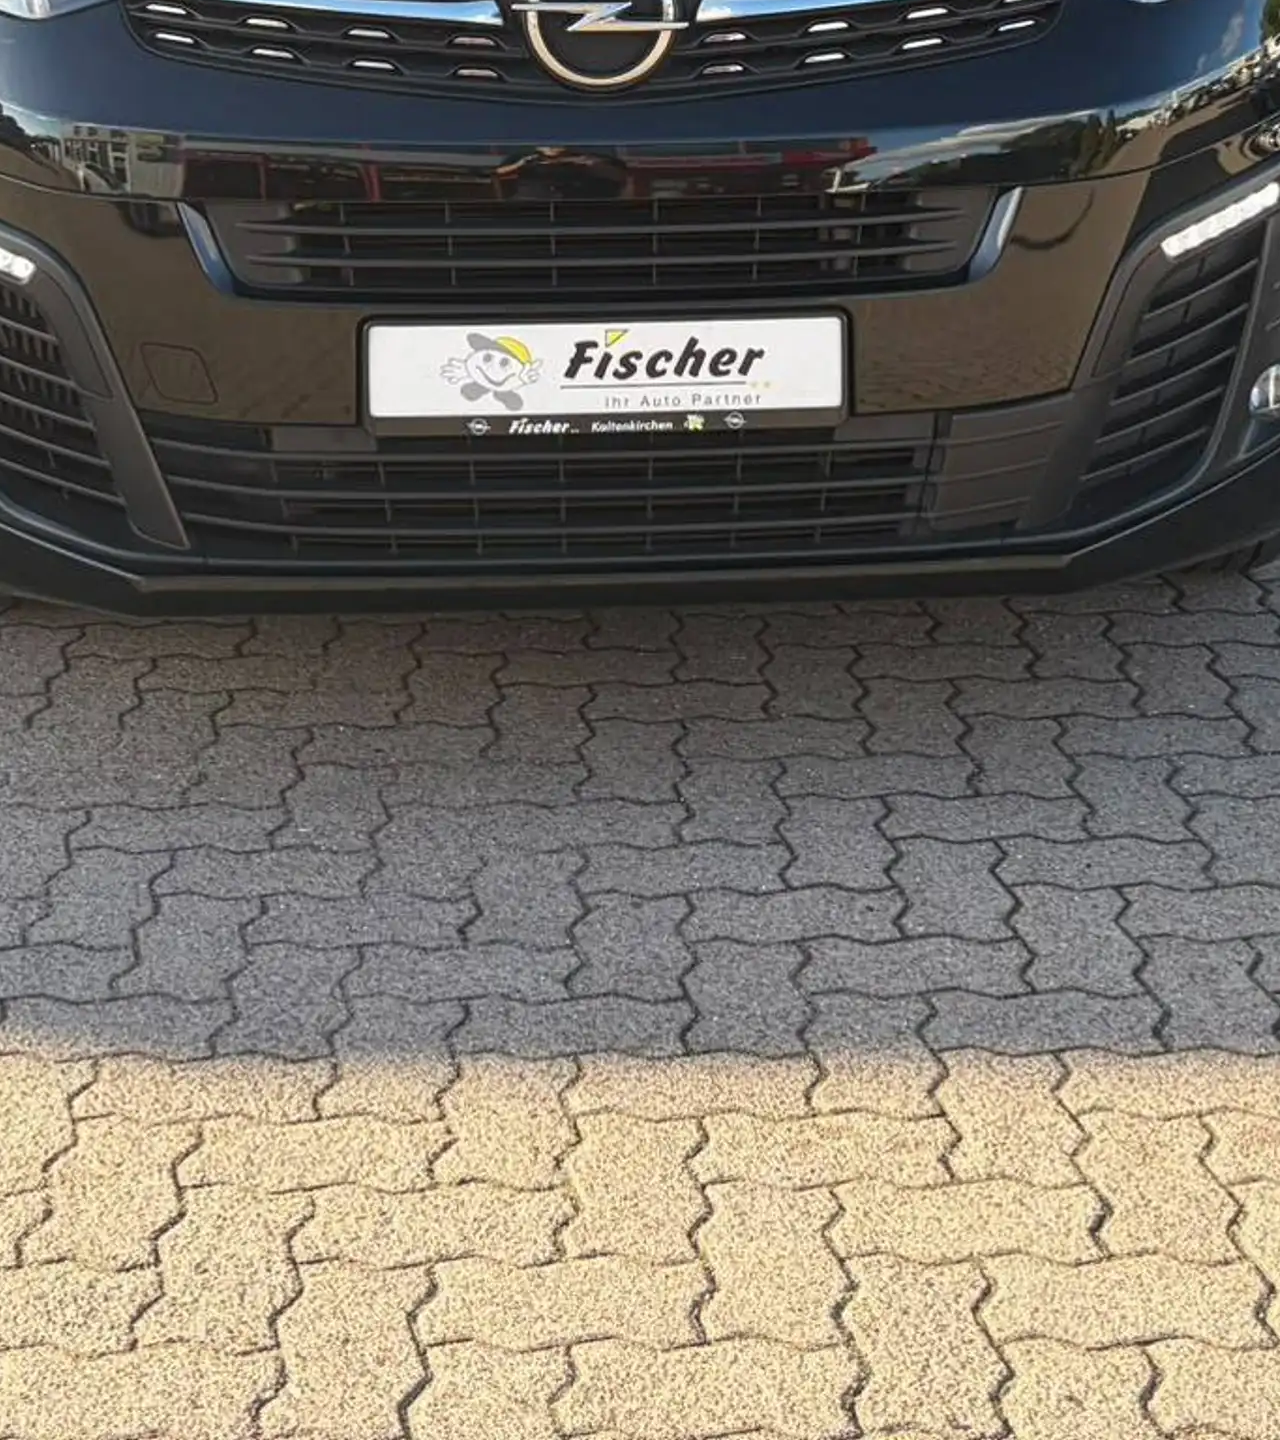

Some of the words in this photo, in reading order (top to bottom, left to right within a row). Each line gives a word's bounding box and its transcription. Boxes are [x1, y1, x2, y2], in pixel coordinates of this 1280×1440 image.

[563, 329, 765, 381] Fischer
[605, 395, 630, 409] Ihr
[640, 394, 682, 408] Auto
[691, 392, 762, 407] Partner
[508, 417, 571, 435] Fischer
[591, 418, 674, 433] Kaltenkirchen
